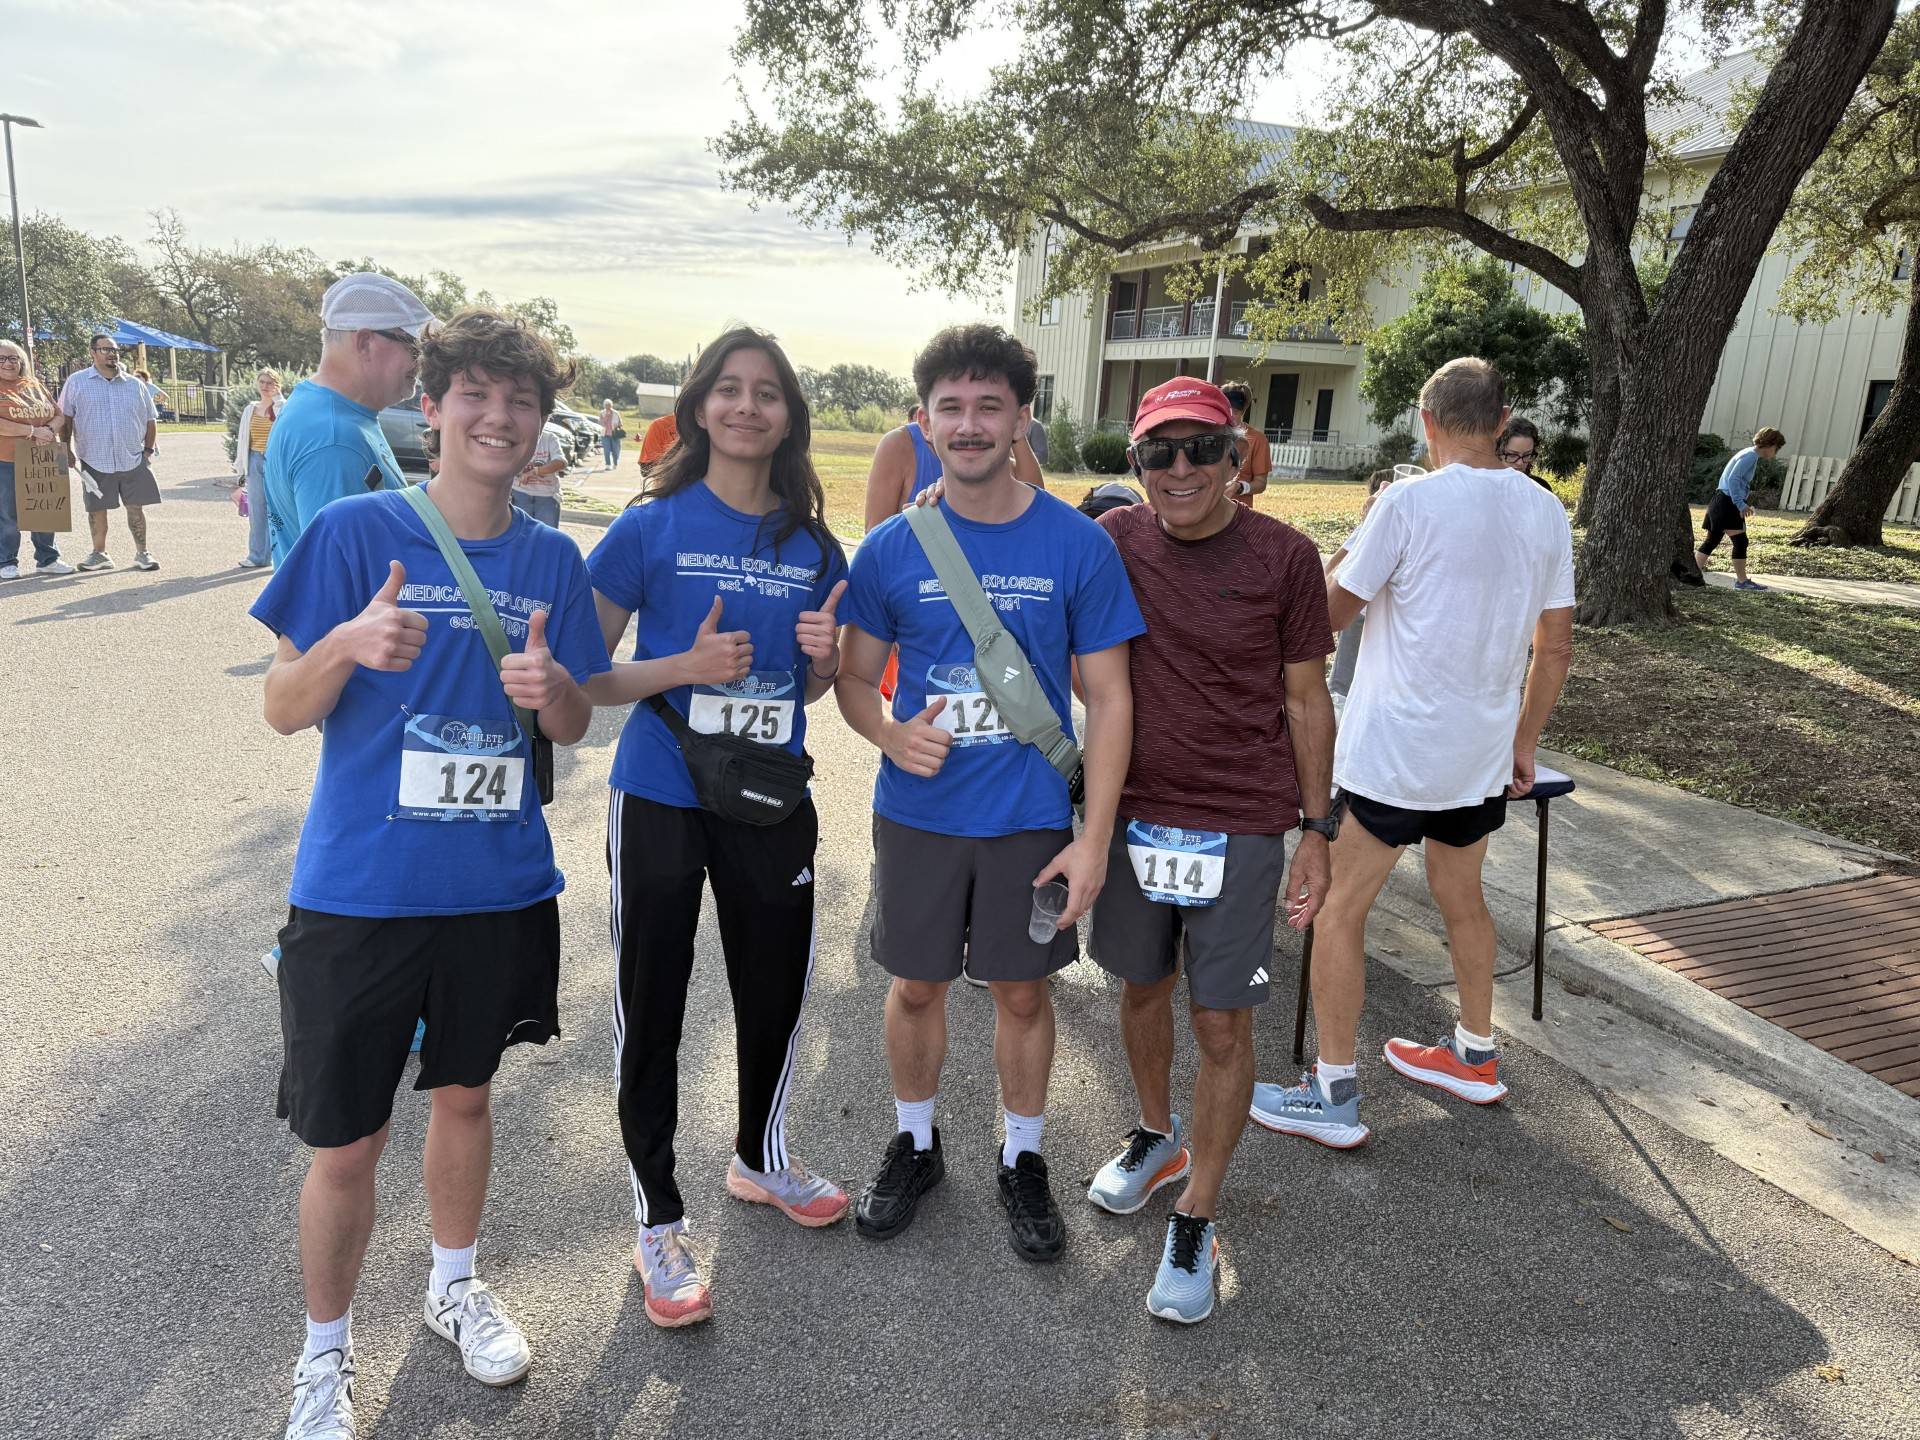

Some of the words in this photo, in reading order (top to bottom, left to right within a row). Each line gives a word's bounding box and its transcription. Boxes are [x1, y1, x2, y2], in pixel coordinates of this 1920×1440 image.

[30, 446, 54, 465] RUN
[676, 552, 739, 570] MEDICAL
[741, 557, 818, 584] EXPLORERS
[396, 583, 468, 603] MEDICA
[718, 579, 745, 592] est.
[757, 582, 789, 598] 1991
[981, 574, 1054, 593] EXPLORERS
[994, 596, 1021, 611] 1991
[720, 703, 781, 740] 125
[951, 697, 1005, 734] 12
[460, 732, 504, 744] ATHLETE
[437, 761, 508, 805] 124
[1164, 832, 1202, 843] ALETE
[1144, 854, 1203, 893] 114
[1280, 1098, 1324, 1115] HOKA
